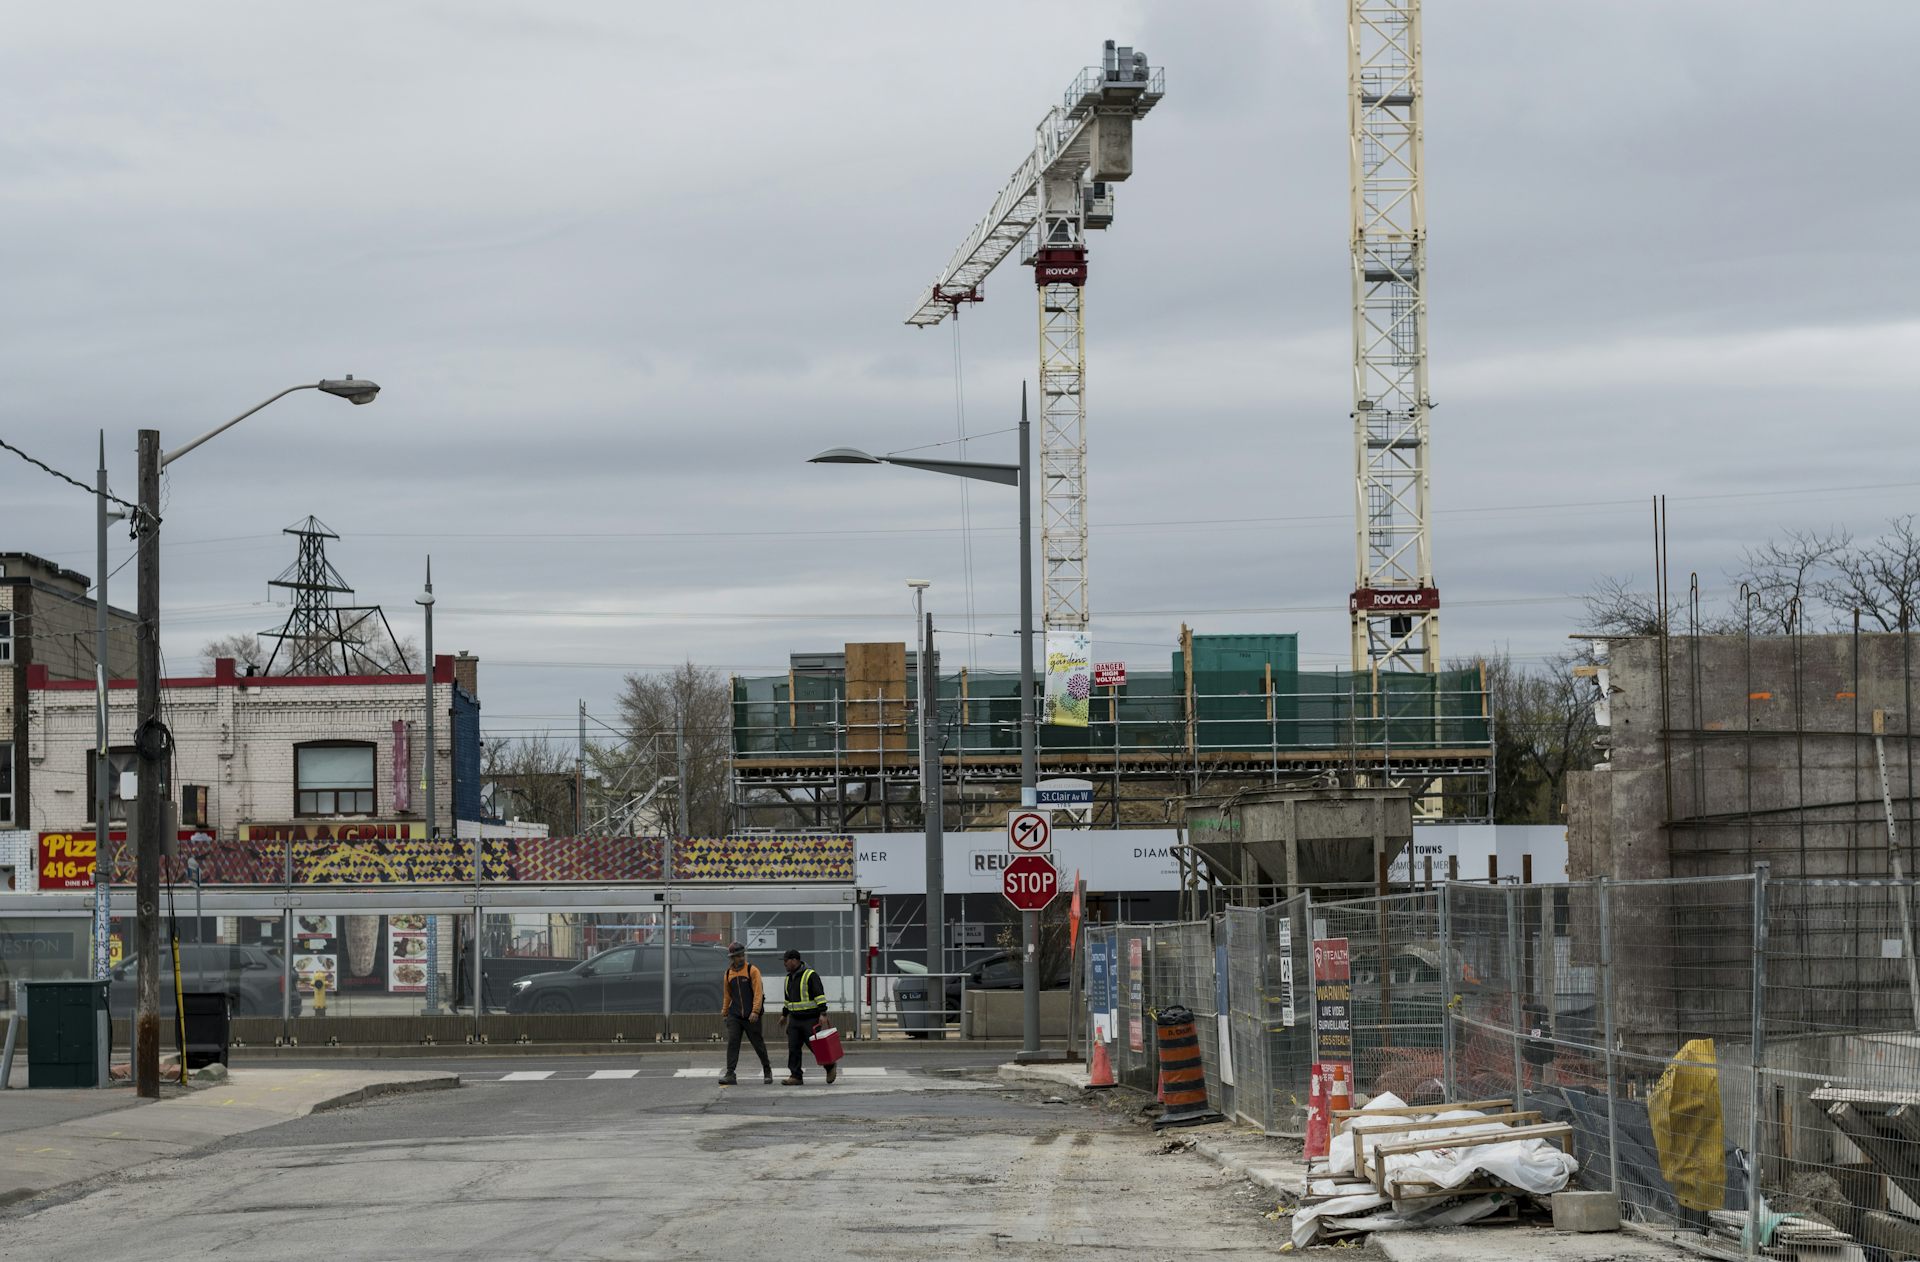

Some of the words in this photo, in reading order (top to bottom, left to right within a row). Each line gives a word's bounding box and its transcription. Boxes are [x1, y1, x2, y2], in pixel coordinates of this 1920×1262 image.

[1374, 594, 1422, 604] ROYCAP
[1048, 653, 1087, 675] gardens
[1096, 663, 1123, 671] DANGER
[1081, 792, 1088, 800] W
[1415, 845, 1442, 854] TOWNS
[859, 852, 886, 861] MER
[1006, 872, 1054, 893] STOP
[1323, 950, 1348, 959] STEALTH
[1317, 985, 1349, 1000] WARNING
[1322, 1006, 1331, 1016] LIVE
[1332, 1006, 1344, 1016] VIDEO
[1318, 1020, 1349, 1030] SURVEILLANCE
